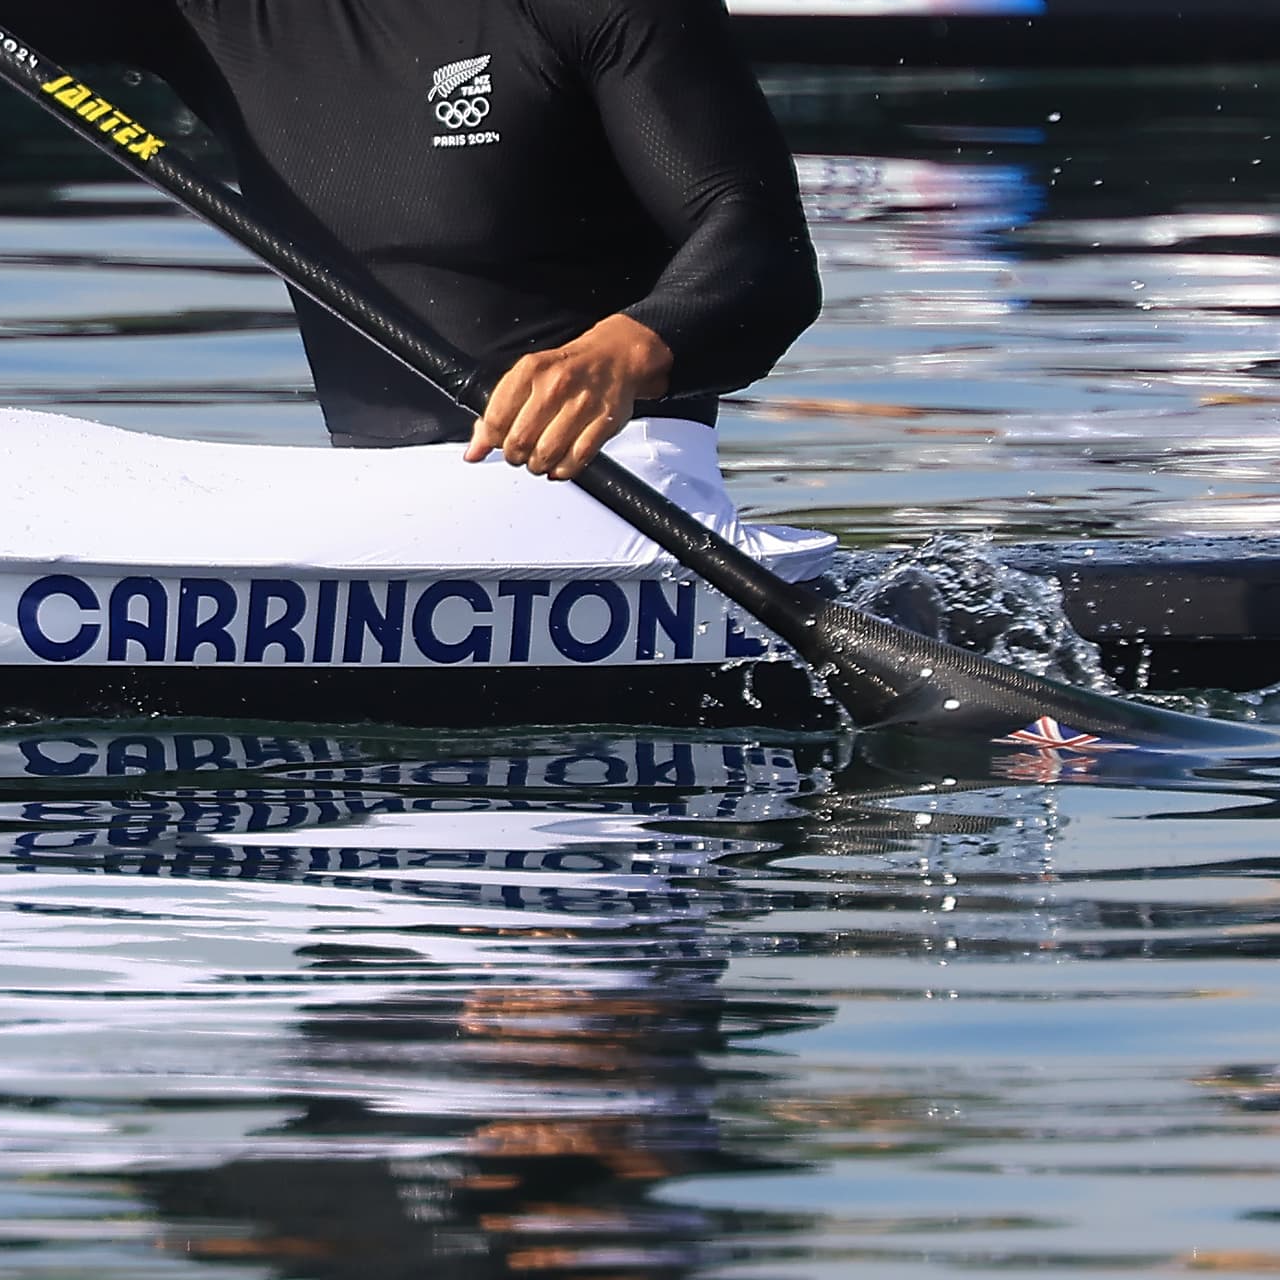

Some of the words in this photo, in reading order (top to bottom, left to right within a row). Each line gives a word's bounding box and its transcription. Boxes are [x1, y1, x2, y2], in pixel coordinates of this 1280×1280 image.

[461, 84, 492, 96] TEAM
[433, 134, 466, 147] PARIS
[467, 131, 500, 145] 2024
[16, 574, 696, 663] CARRINGTON
